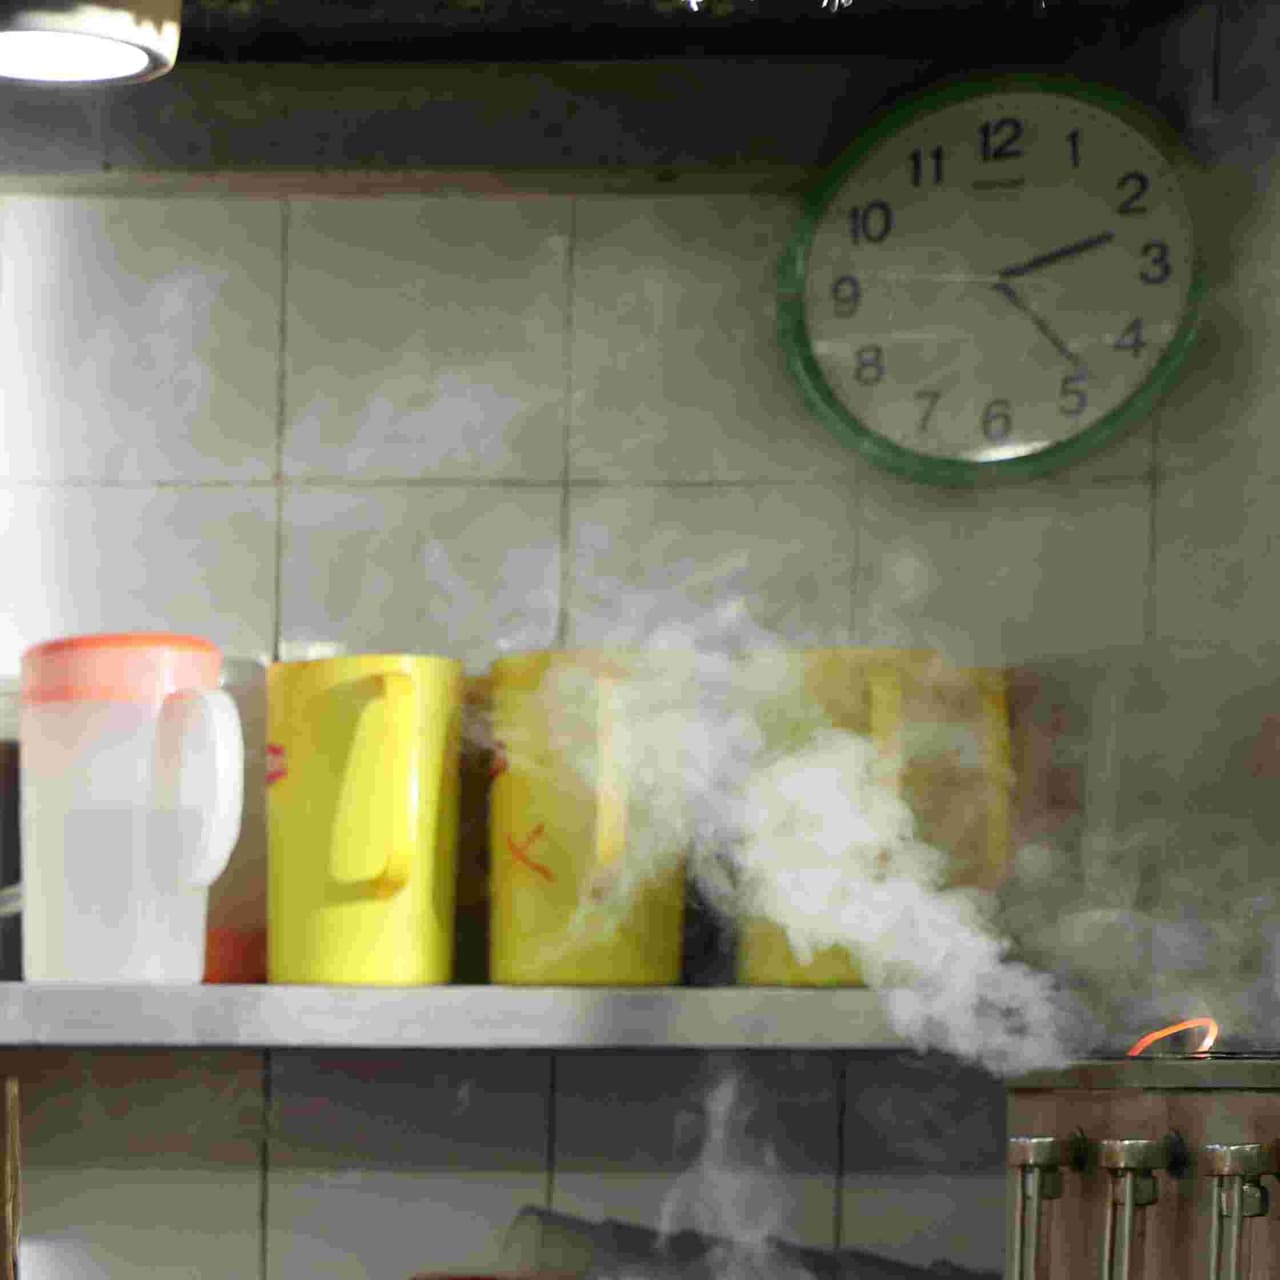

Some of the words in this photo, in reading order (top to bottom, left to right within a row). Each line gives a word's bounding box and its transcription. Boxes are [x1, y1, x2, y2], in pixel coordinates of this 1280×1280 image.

[978, 118, 1024, 161] 12
[1066, 128, 1081, 168] 1
[910, 145, 944, 187] 11
[1116, 171, 1150, 216] 2
[849, 201, 893, 245] 10
[1140, 239, 1171, 285] 3
[831, 275, 860, 319] 9
[1113, 319, 1146, 358] 4
[854, 345, 884, 386] 8
[915, 390, 939, 431] 7
[1060, 370, 1088, 417] 5
[982, 400, 1011, 441] 6
